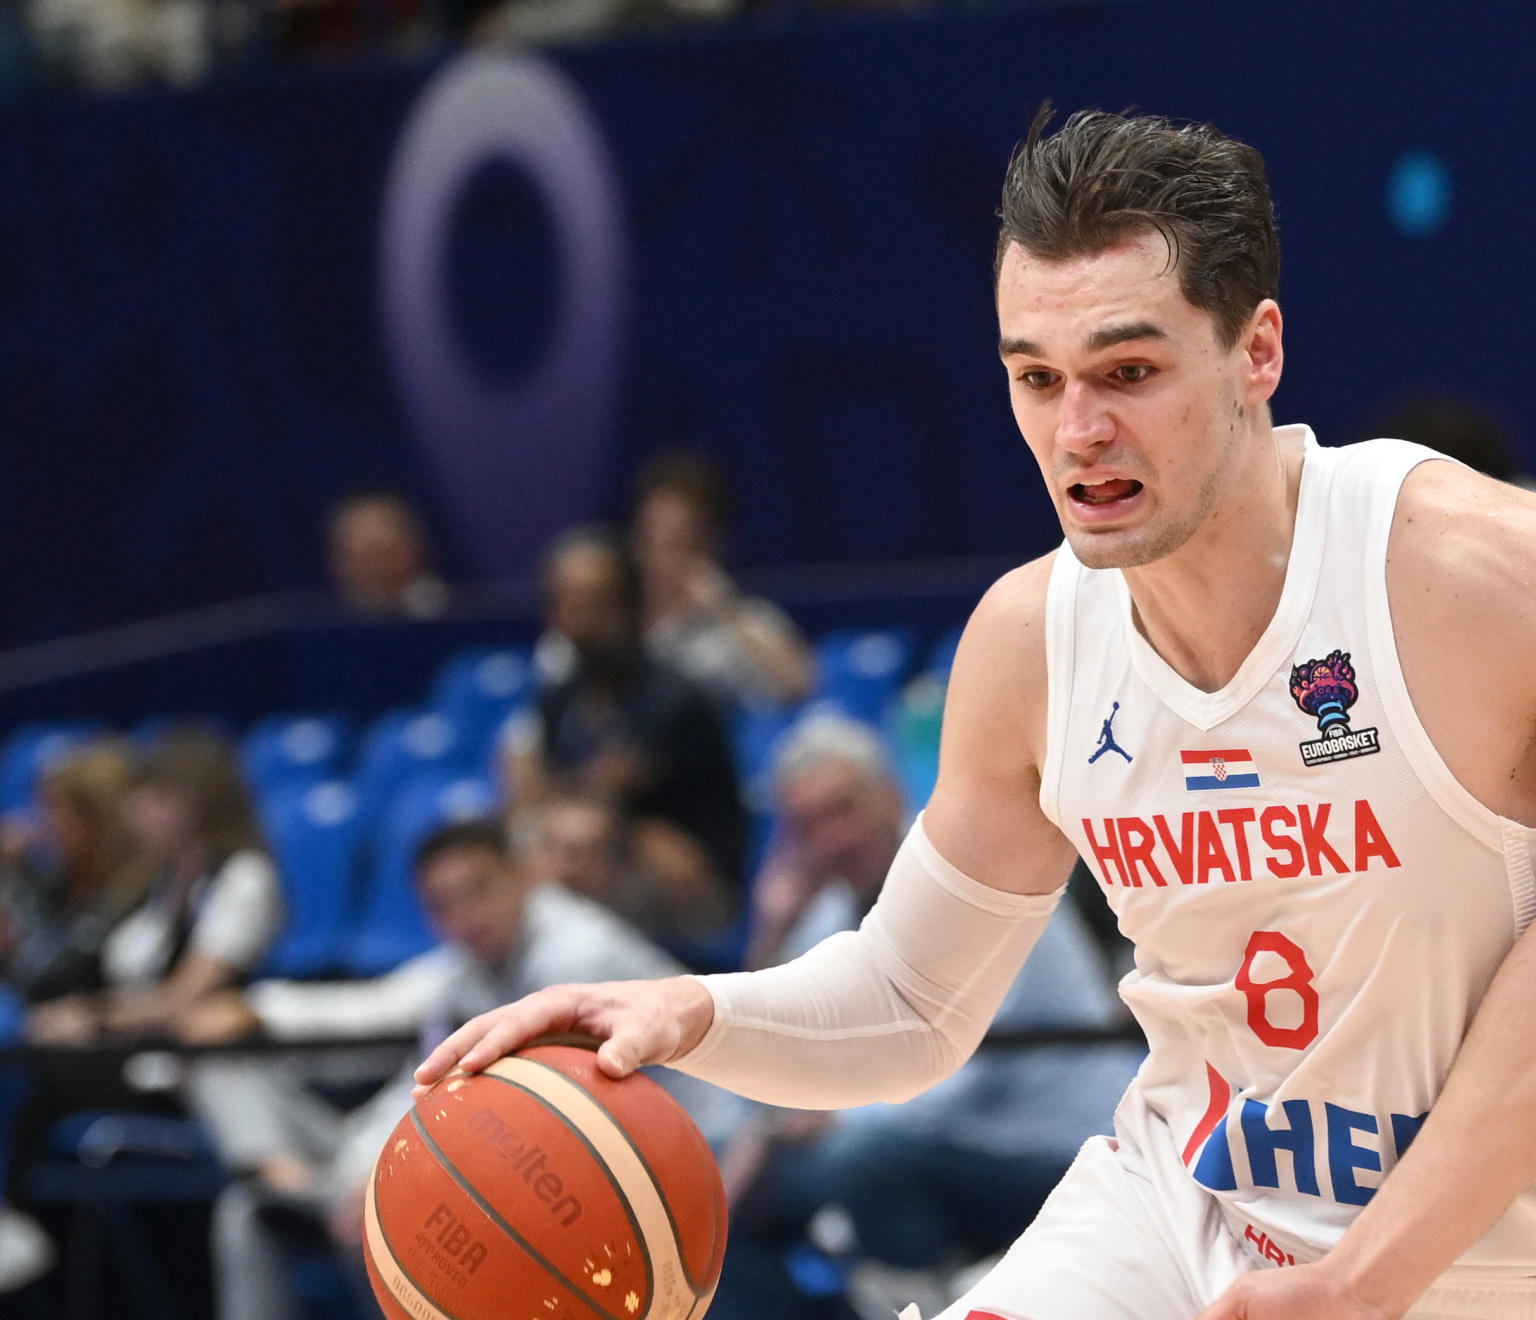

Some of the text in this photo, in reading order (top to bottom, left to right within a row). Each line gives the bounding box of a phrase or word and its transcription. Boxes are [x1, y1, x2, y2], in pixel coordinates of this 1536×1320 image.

[1301, 730, 1377, 759] EUROBASKET
[1082, 799, 1402, 888] HRVATSKA
[1235, 930, 1319, 1051] 8
[468, 1107, 583, 1229] molten
[424, 1202, 488, 1275] FIBA
